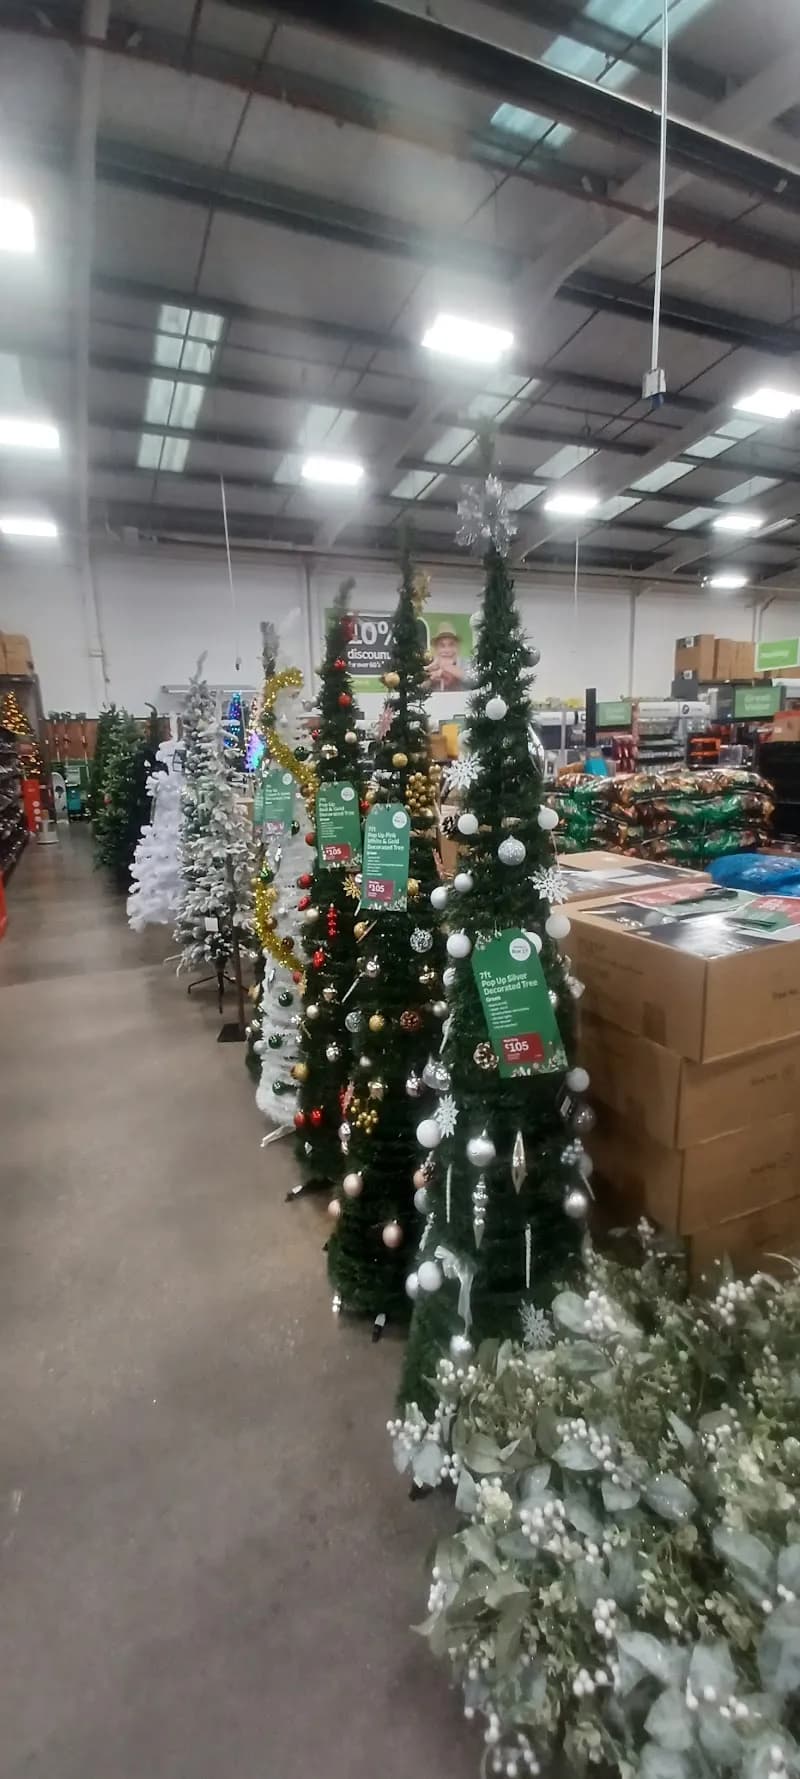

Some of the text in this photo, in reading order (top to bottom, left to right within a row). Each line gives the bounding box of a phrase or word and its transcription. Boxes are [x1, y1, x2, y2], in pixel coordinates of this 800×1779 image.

[479, 971, 492, 979] 7ft
[481, 973, 528, 987] Pop Up Silver
[483, 980, 539, 996] Decorated Tree
[504, 1041, 529, 1053] £105
